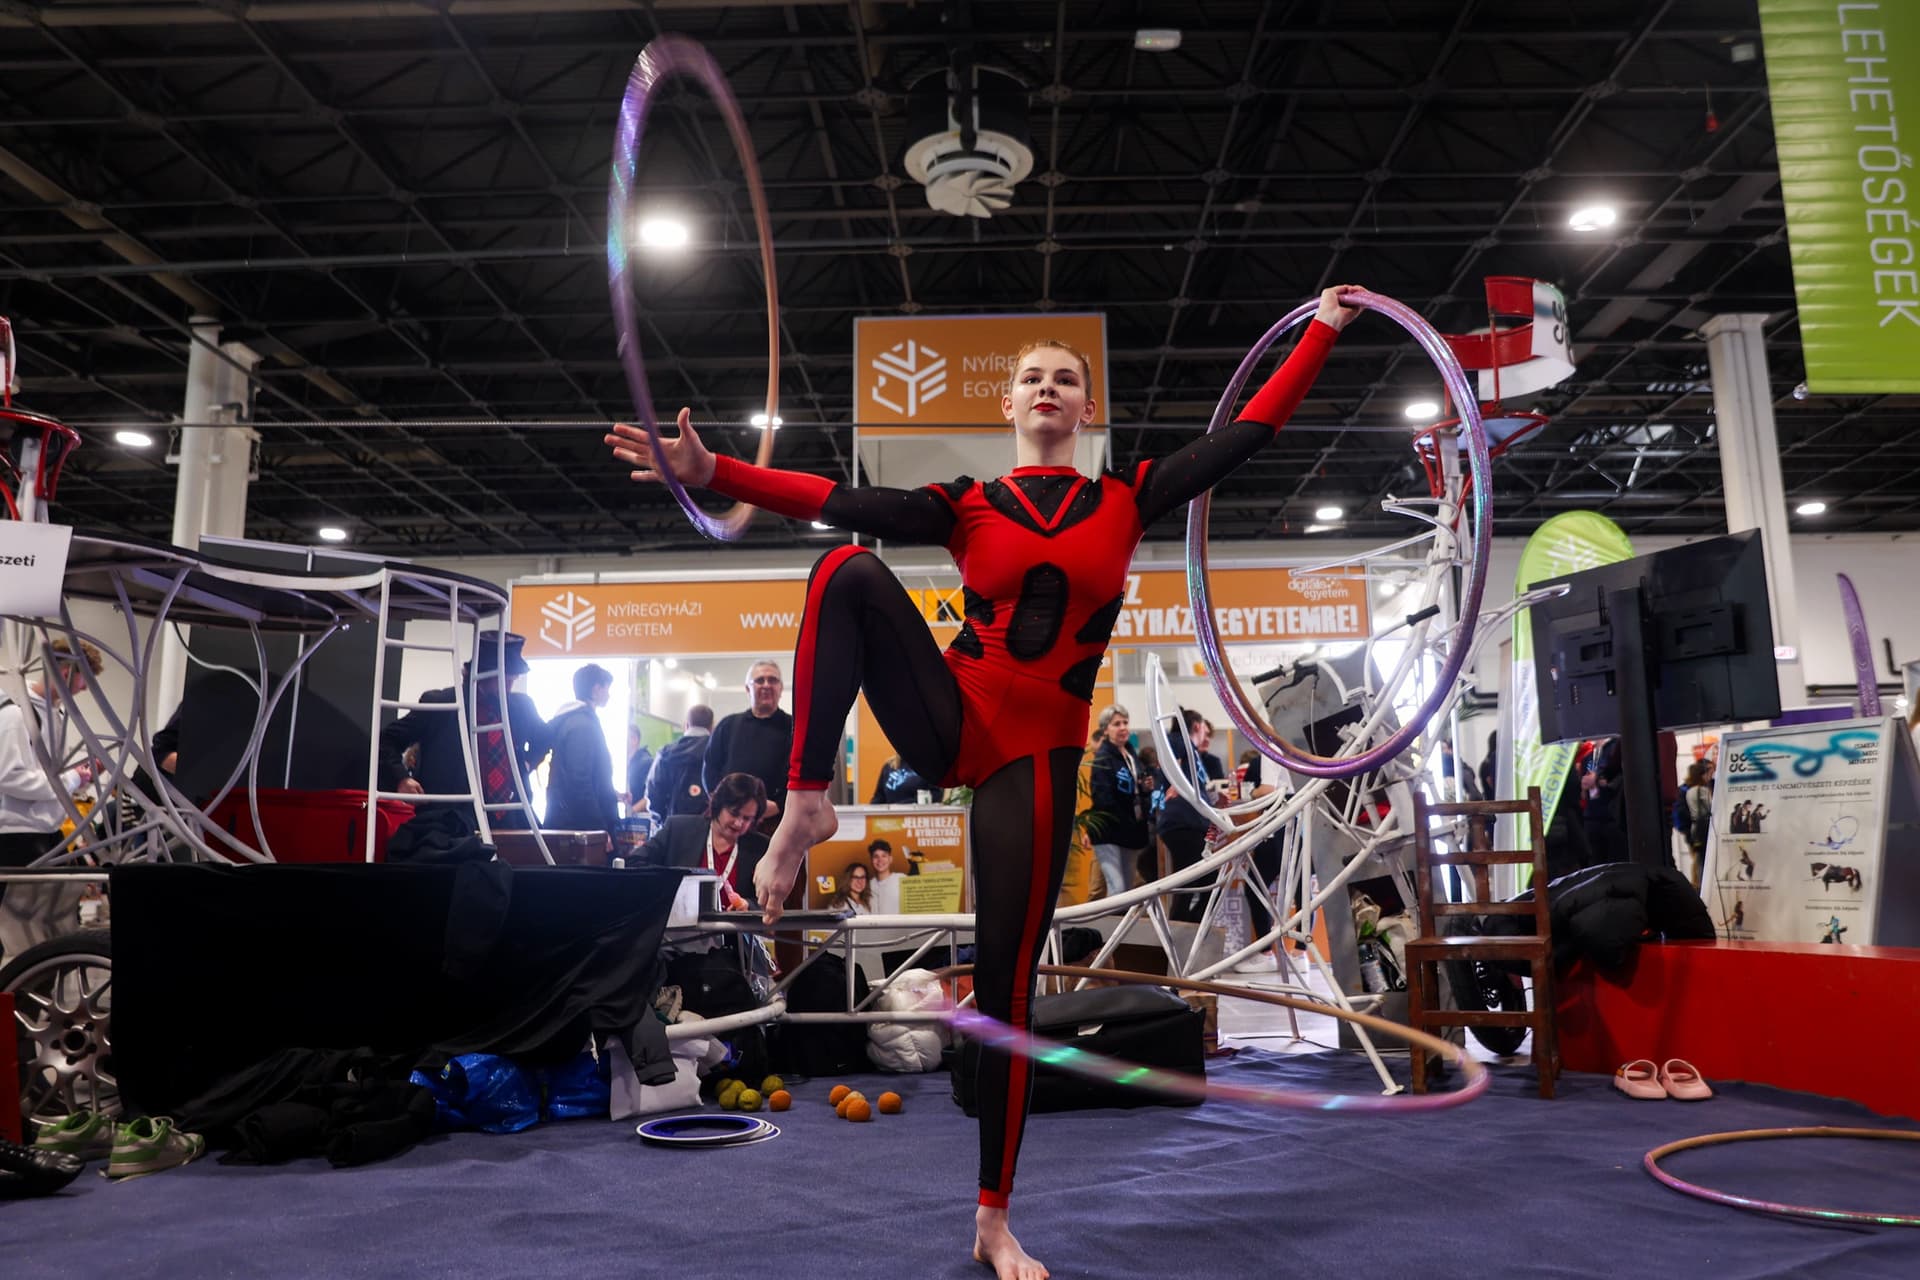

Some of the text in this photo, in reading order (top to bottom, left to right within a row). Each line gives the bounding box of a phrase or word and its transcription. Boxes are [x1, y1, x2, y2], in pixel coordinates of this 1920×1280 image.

[1837, 3, 1920, 329] LEHETŐSÉGEK
[963, 381, 1011, 398] EGYE
[607, 599, 703, 616] NYÍREGYHÁZI
[1215, 605, 1358, 635] EGYETEMRE!
[607, 622, 673, 637] EGYETEM
